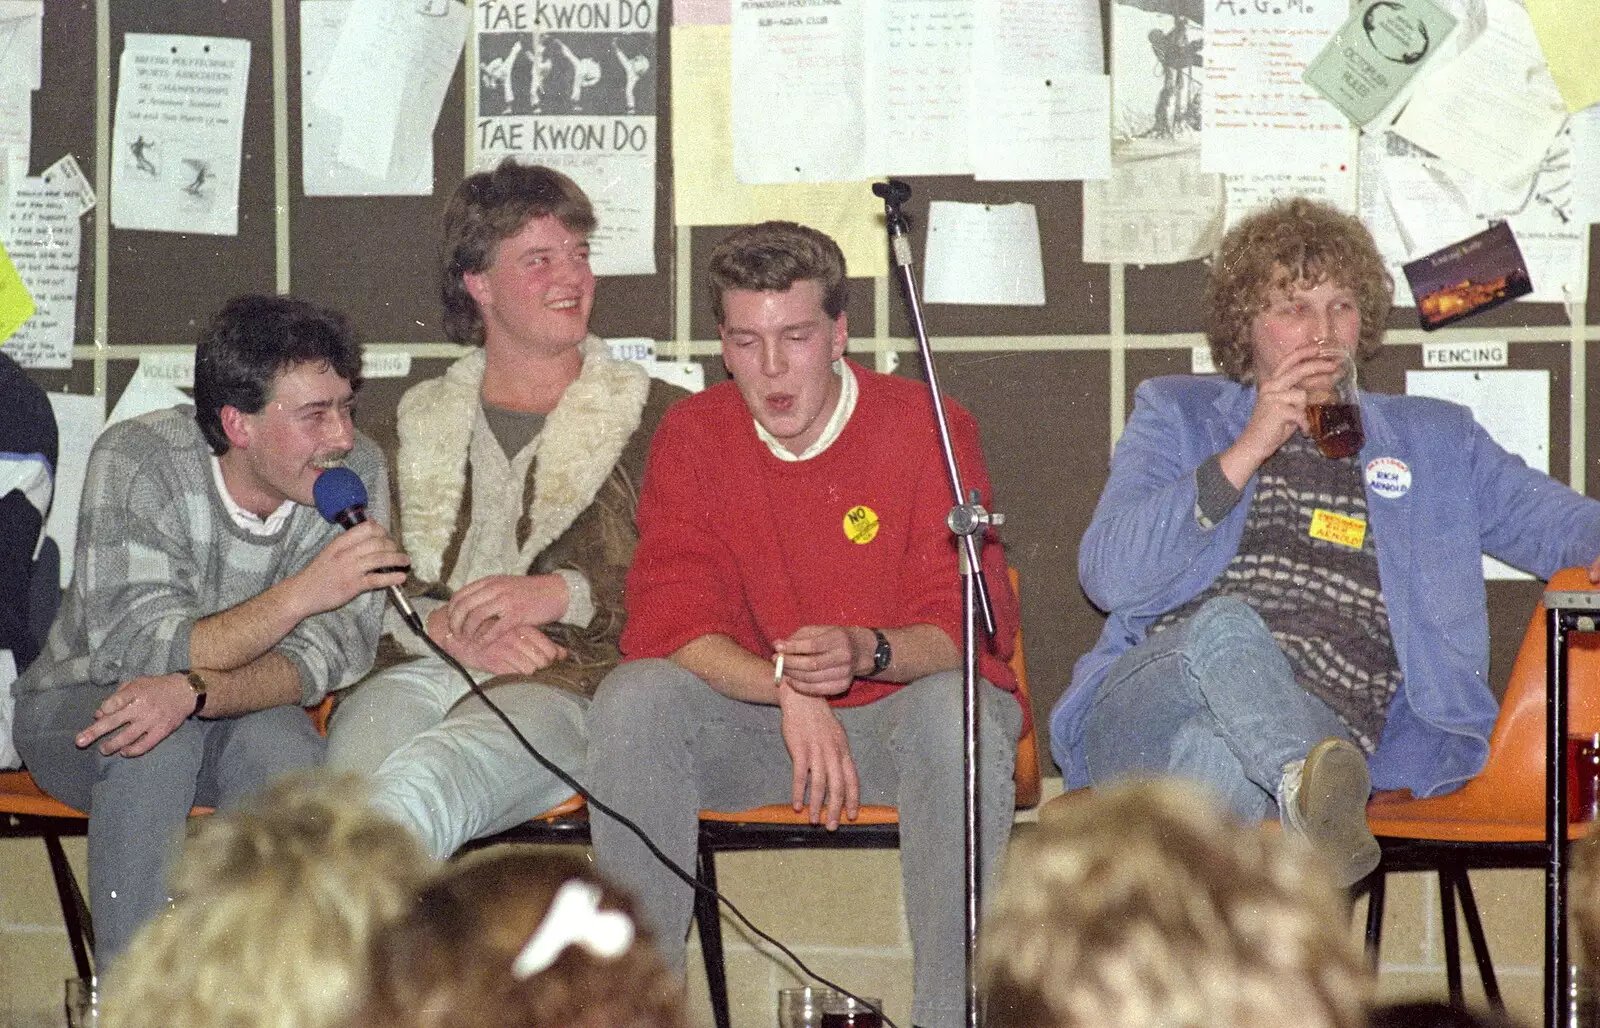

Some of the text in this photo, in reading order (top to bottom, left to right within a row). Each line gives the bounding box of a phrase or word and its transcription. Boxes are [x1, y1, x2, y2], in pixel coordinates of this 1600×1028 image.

[478, 0, 651, 29] TAE KWON DO
[477, 119, 647, 151] TAE KWON DO
[1427, 348, 1503, 363] FENCING
[848, 507, 866, 525] NO
